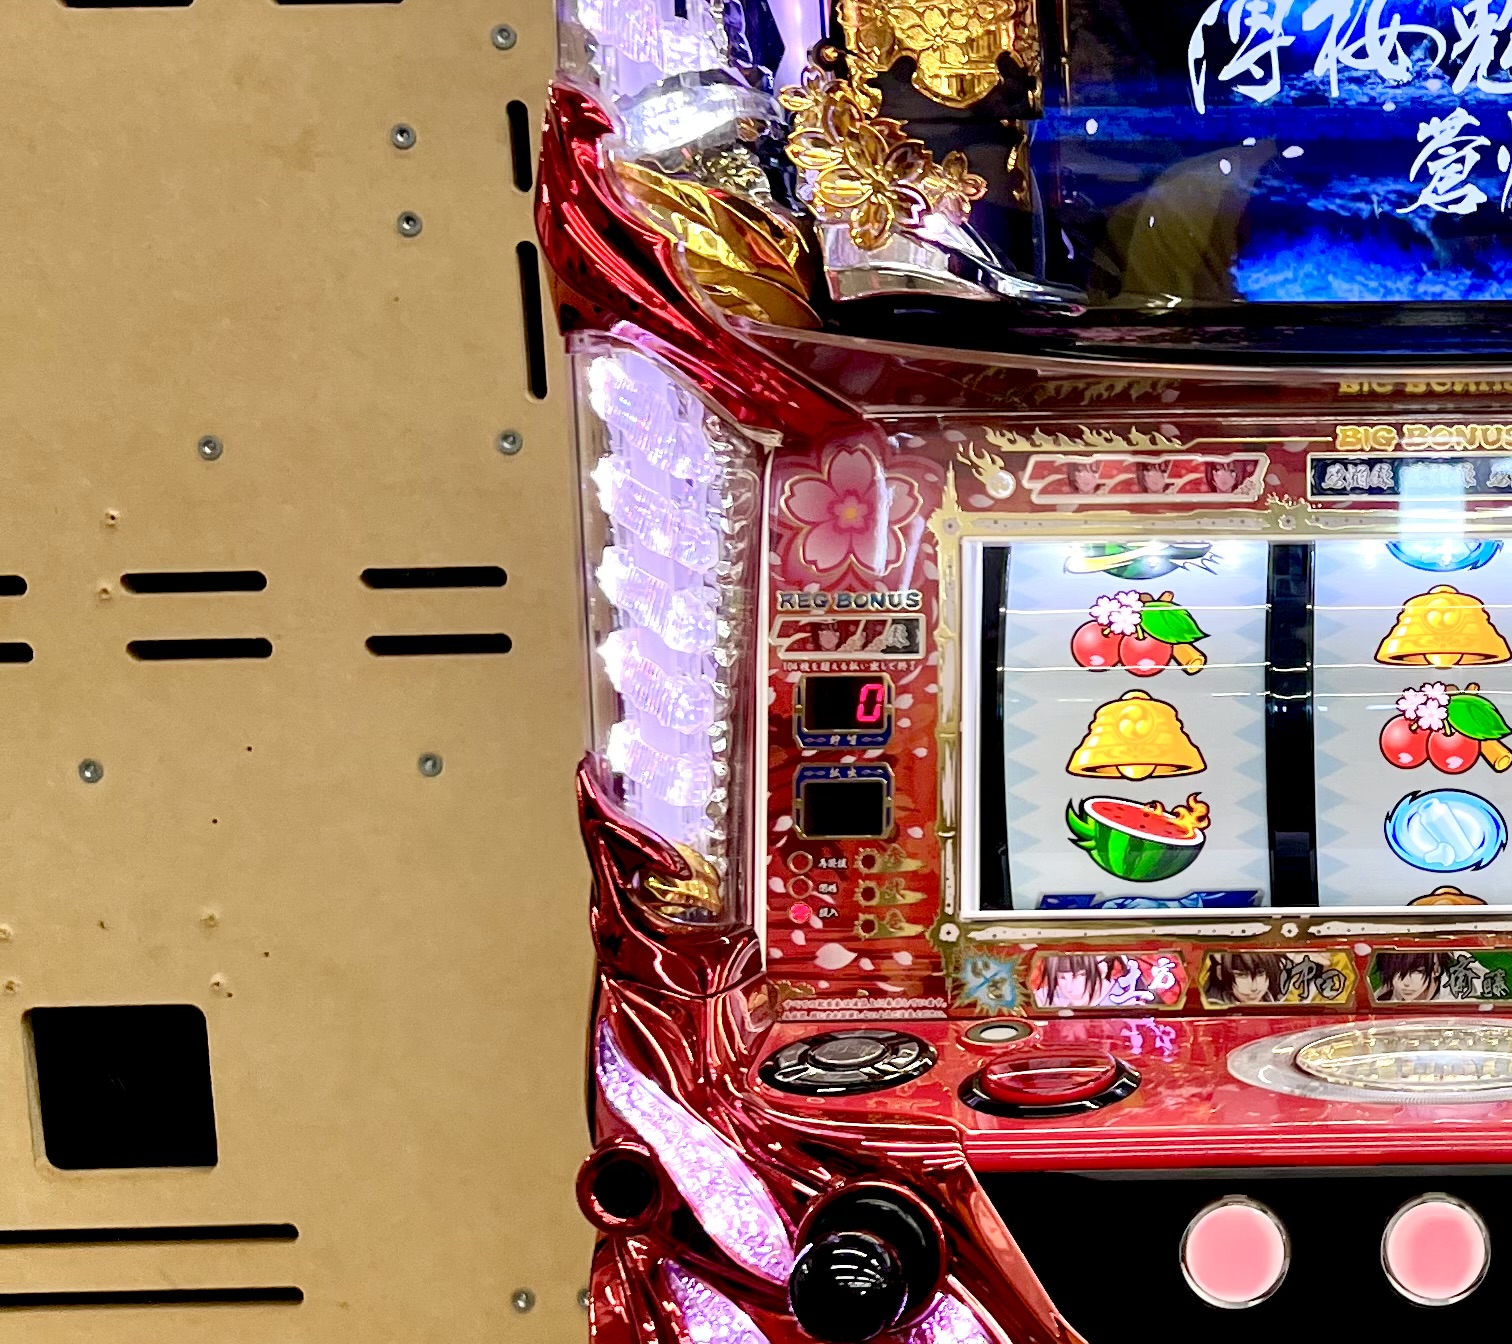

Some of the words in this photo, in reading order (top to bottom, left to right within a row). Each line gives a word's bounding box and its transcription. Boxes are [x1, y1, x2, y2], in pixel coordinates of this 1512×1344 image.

[1336, 424, 1398, 452] BIG
[777, 591, 829, 610] REG
[835, 589, 922, 610] BONUS
[856, 682, 885, 723] 0
